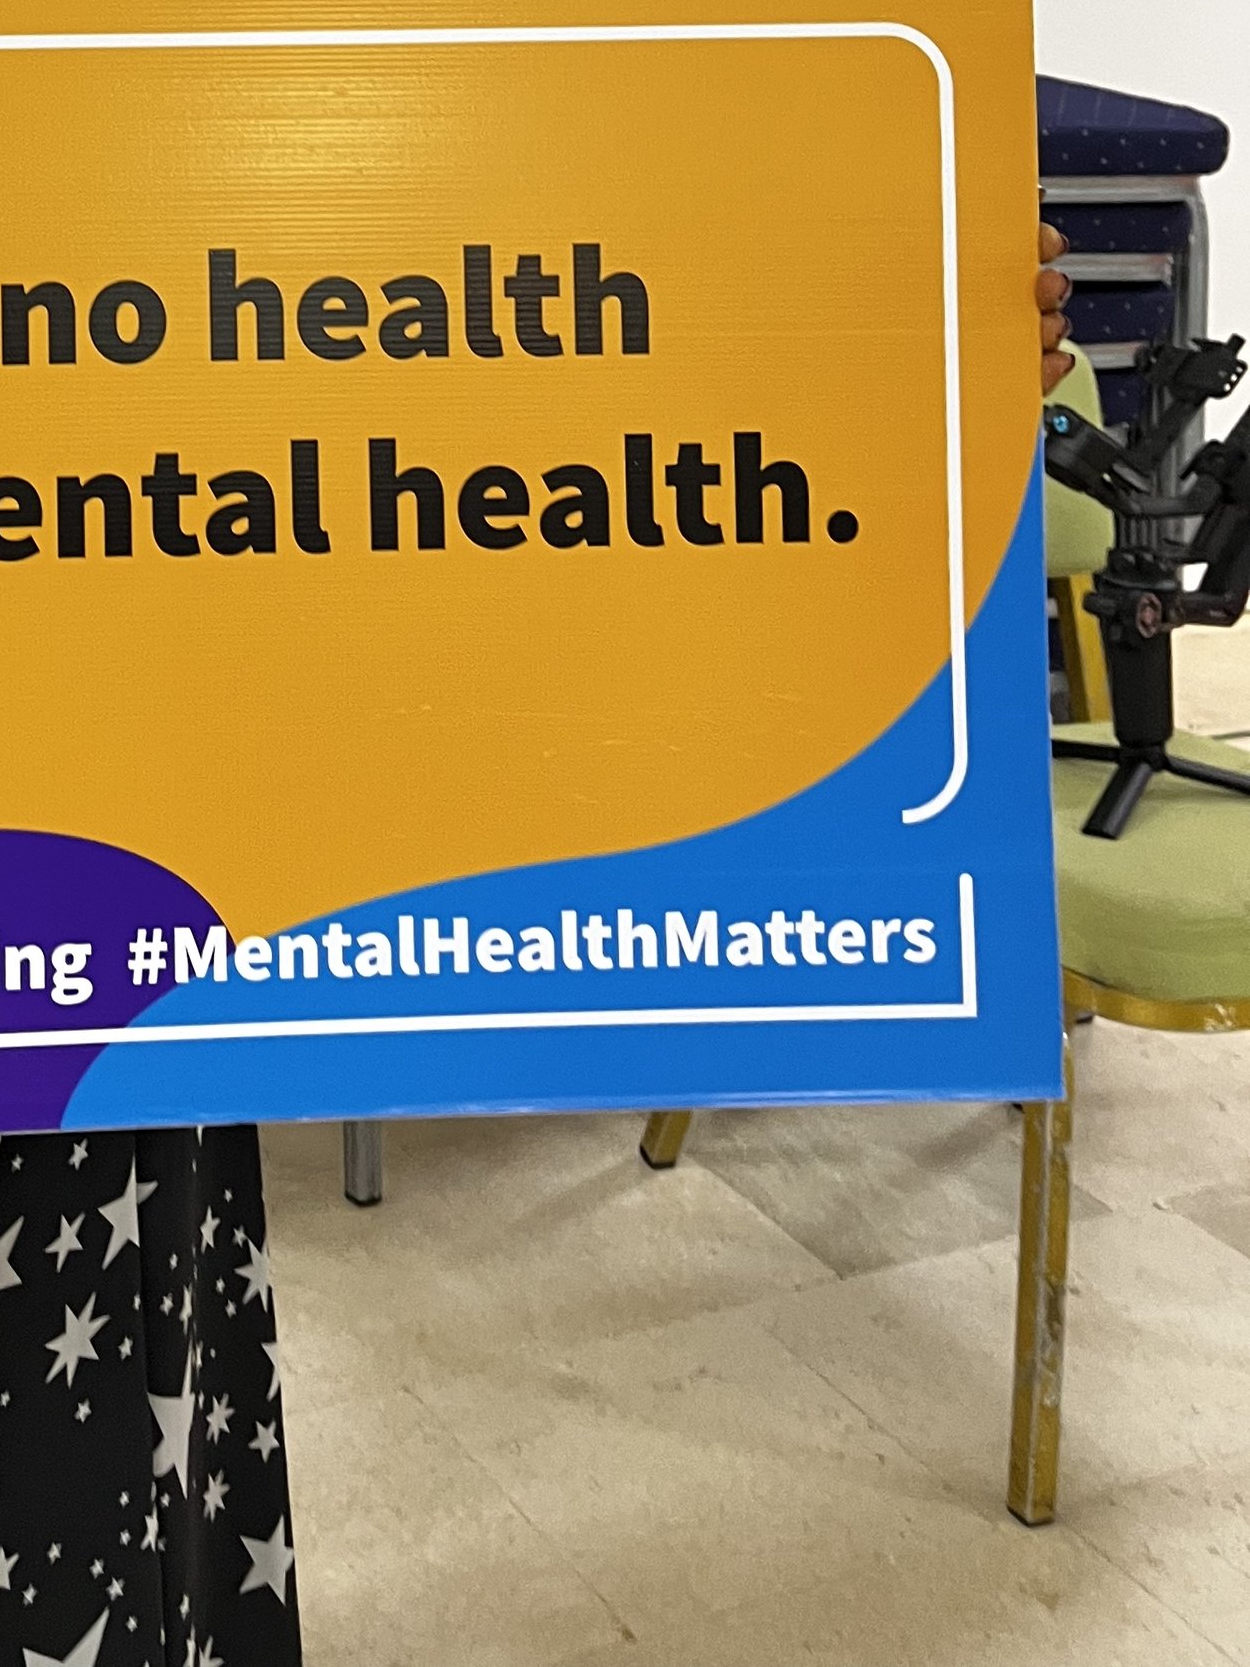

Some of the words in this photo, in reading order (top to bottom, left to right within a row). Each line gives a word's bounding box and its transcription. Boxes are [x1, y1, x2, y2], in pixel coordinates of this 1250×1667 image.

[0, 280, 167, 366] no
[208, 243, 650, 362] health
[368, 431, 859, 552] health.
[127, 909, 937, 985] #MentalHealthMatters
